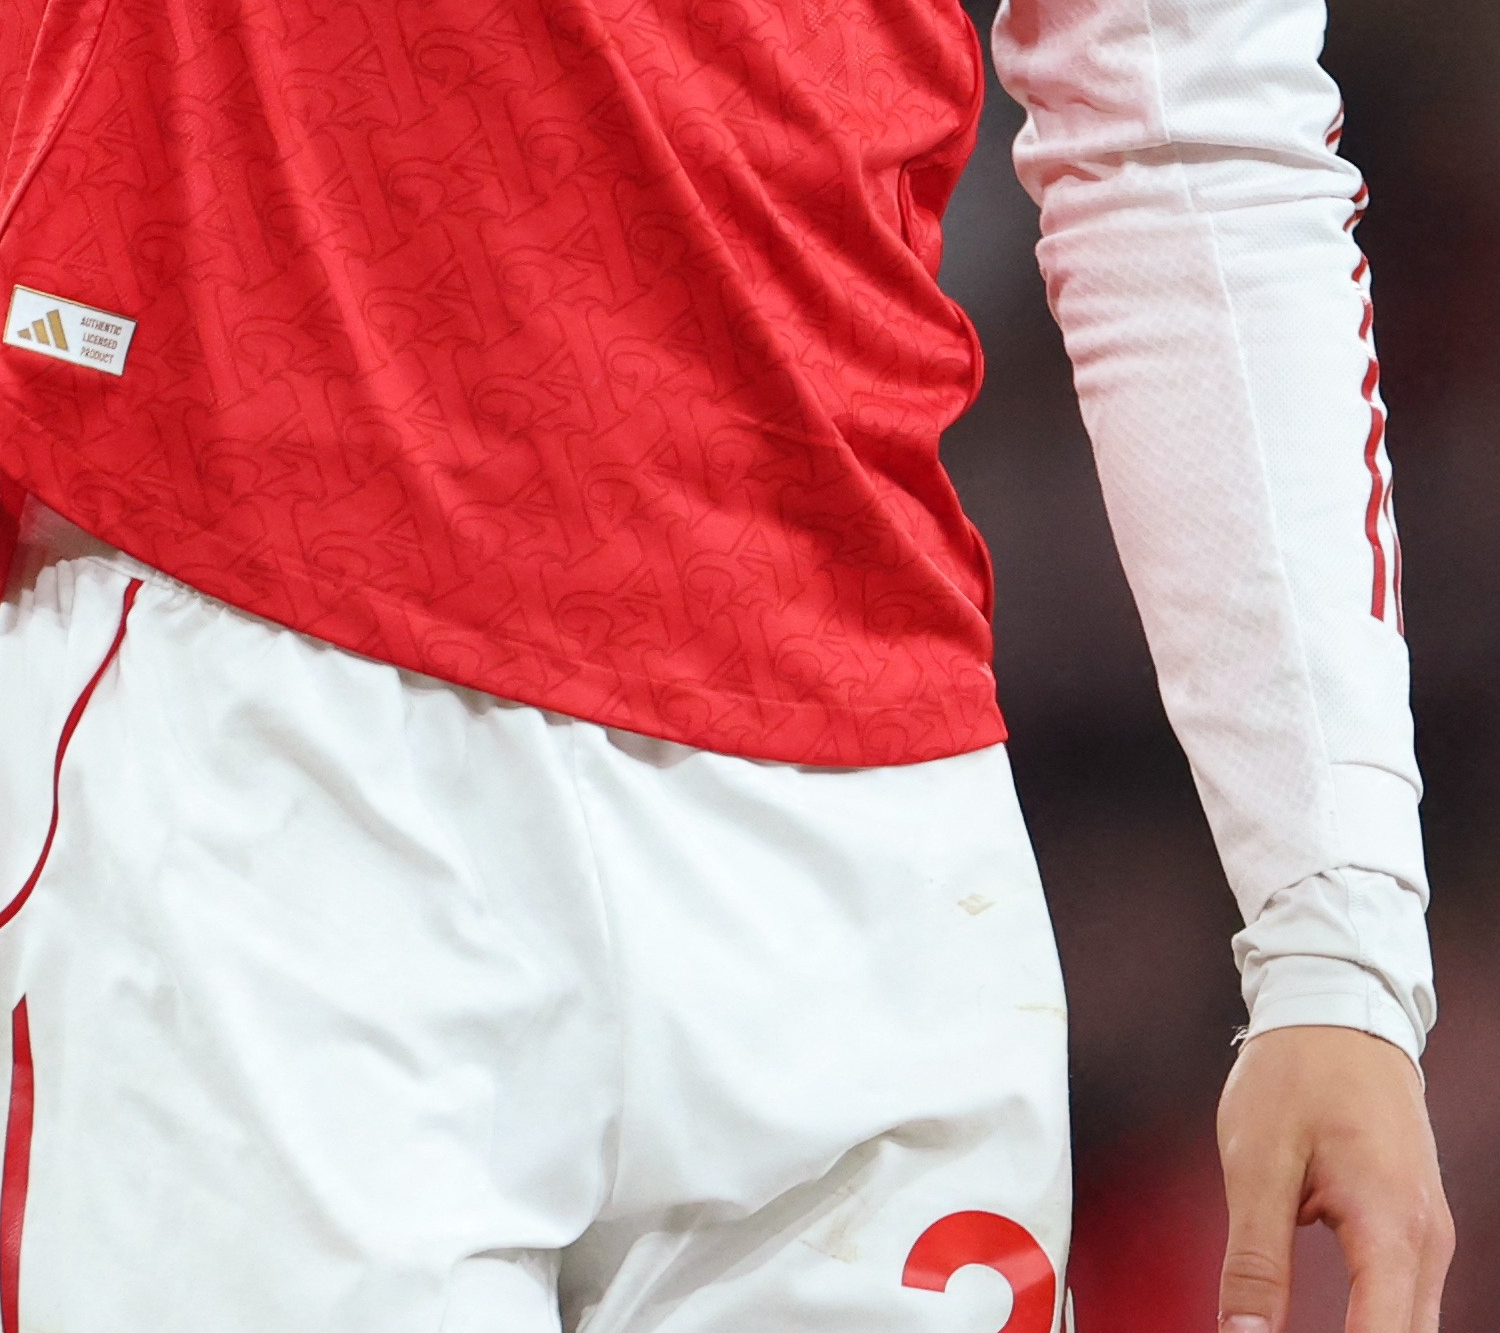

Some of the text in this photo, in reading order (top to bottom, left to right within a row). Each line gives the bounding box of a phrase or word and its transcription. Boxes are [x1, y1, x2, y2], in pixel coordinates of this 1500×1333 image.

[80, 316, 122, 336] AUTHENTIC
[82, 333, 118, 350] LICENSED
[80, 346, 114, 364] PRODUCT
